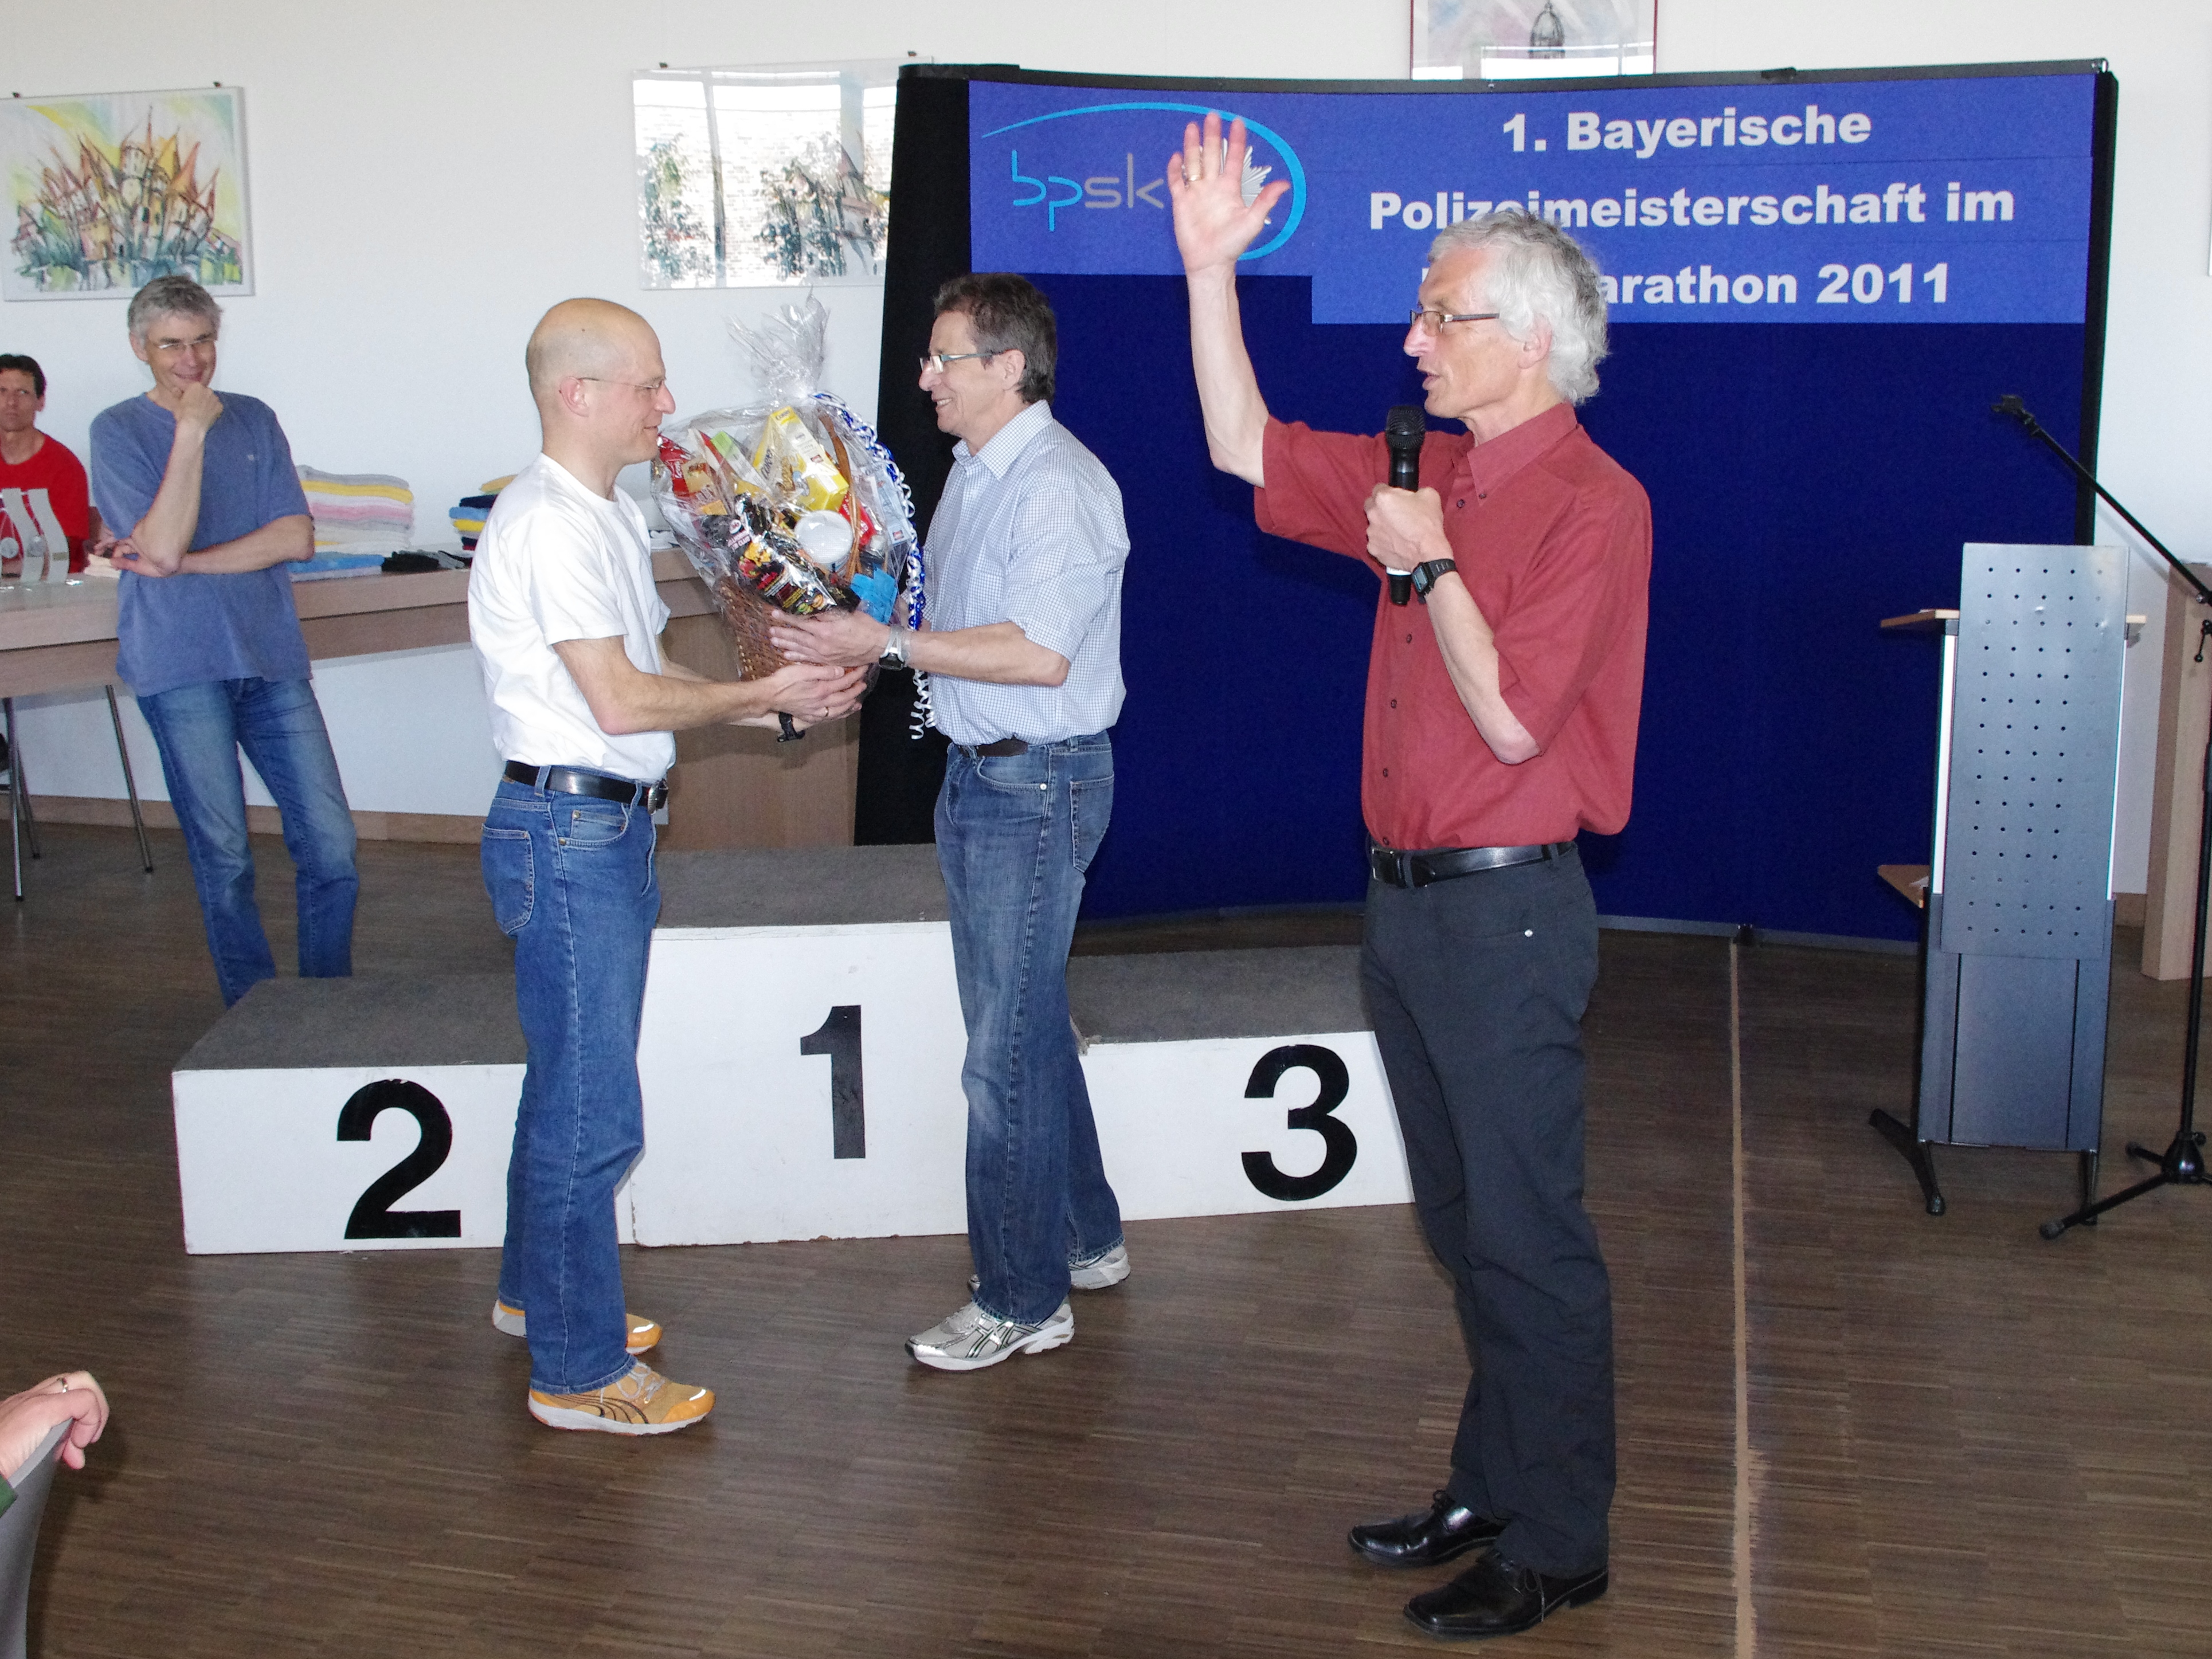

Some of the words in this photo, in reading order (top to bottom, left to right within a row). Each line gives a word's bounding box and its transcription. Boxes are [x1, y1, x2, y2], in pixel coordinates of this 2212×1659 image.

[1503, 113, 1547, 152] 1.
[1567, 104, 1872, 159] Bayerische
[1011, 149, 1165, 232] bpsk
[1946, 181, 2014, 222] im
[1816, 262, 1948, 304] 2011
[800, 1005, 866, 1159] 1
[1241, 1044, 1358, 1201] 3
[336, 1078, 462, 1240] 2
